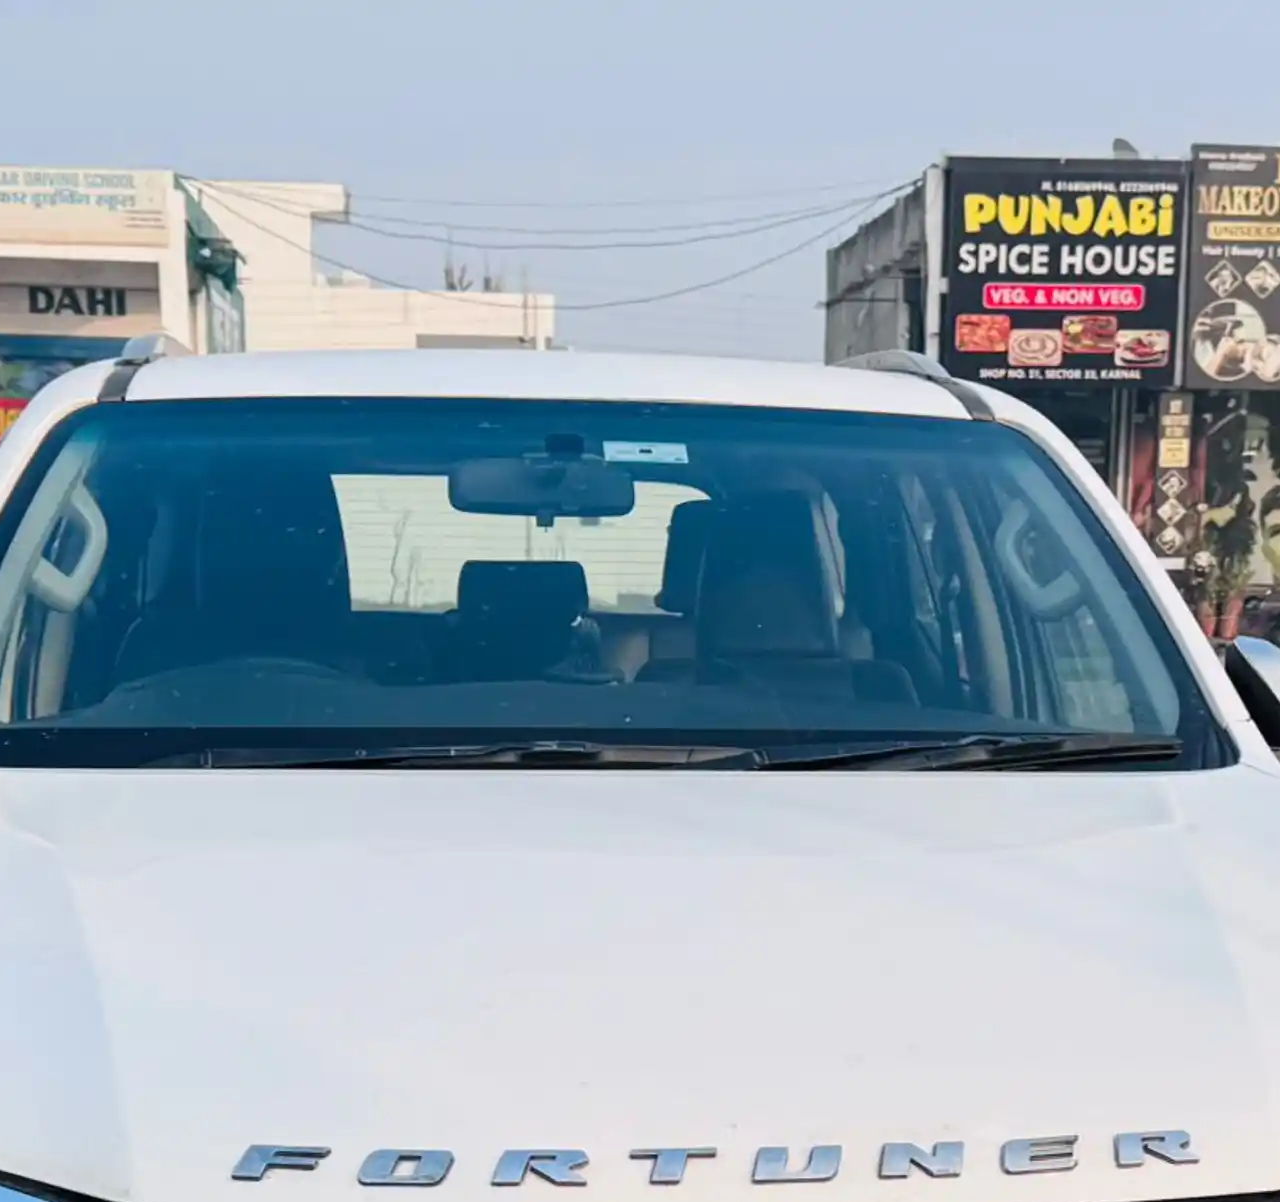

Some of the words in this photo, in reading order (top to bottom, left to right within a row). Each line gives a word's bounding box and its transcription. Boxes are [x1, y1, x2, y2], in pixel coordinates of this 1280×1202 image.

[83, 173, 135, 189] SCHOOL
[1213, 225, 1262, 237] UNISEX
[958, 243, 1050, 274] SPICE
[1060, 244, 1176, 276] HOUSE
[28, 286, 126, 316] DAHI
[989, 289, 1029, 304] VEG.
[1034, 290, 1047, 304] &
[1052, 290, 1095, 305] NON
[1098, 290, 1136, 305] VEG.
[979, 369, 1006, 380] SHOP
[1045, 369, 1081, 380] SECTOR
[231, 1131, 1200, 1186] FORTUNER
